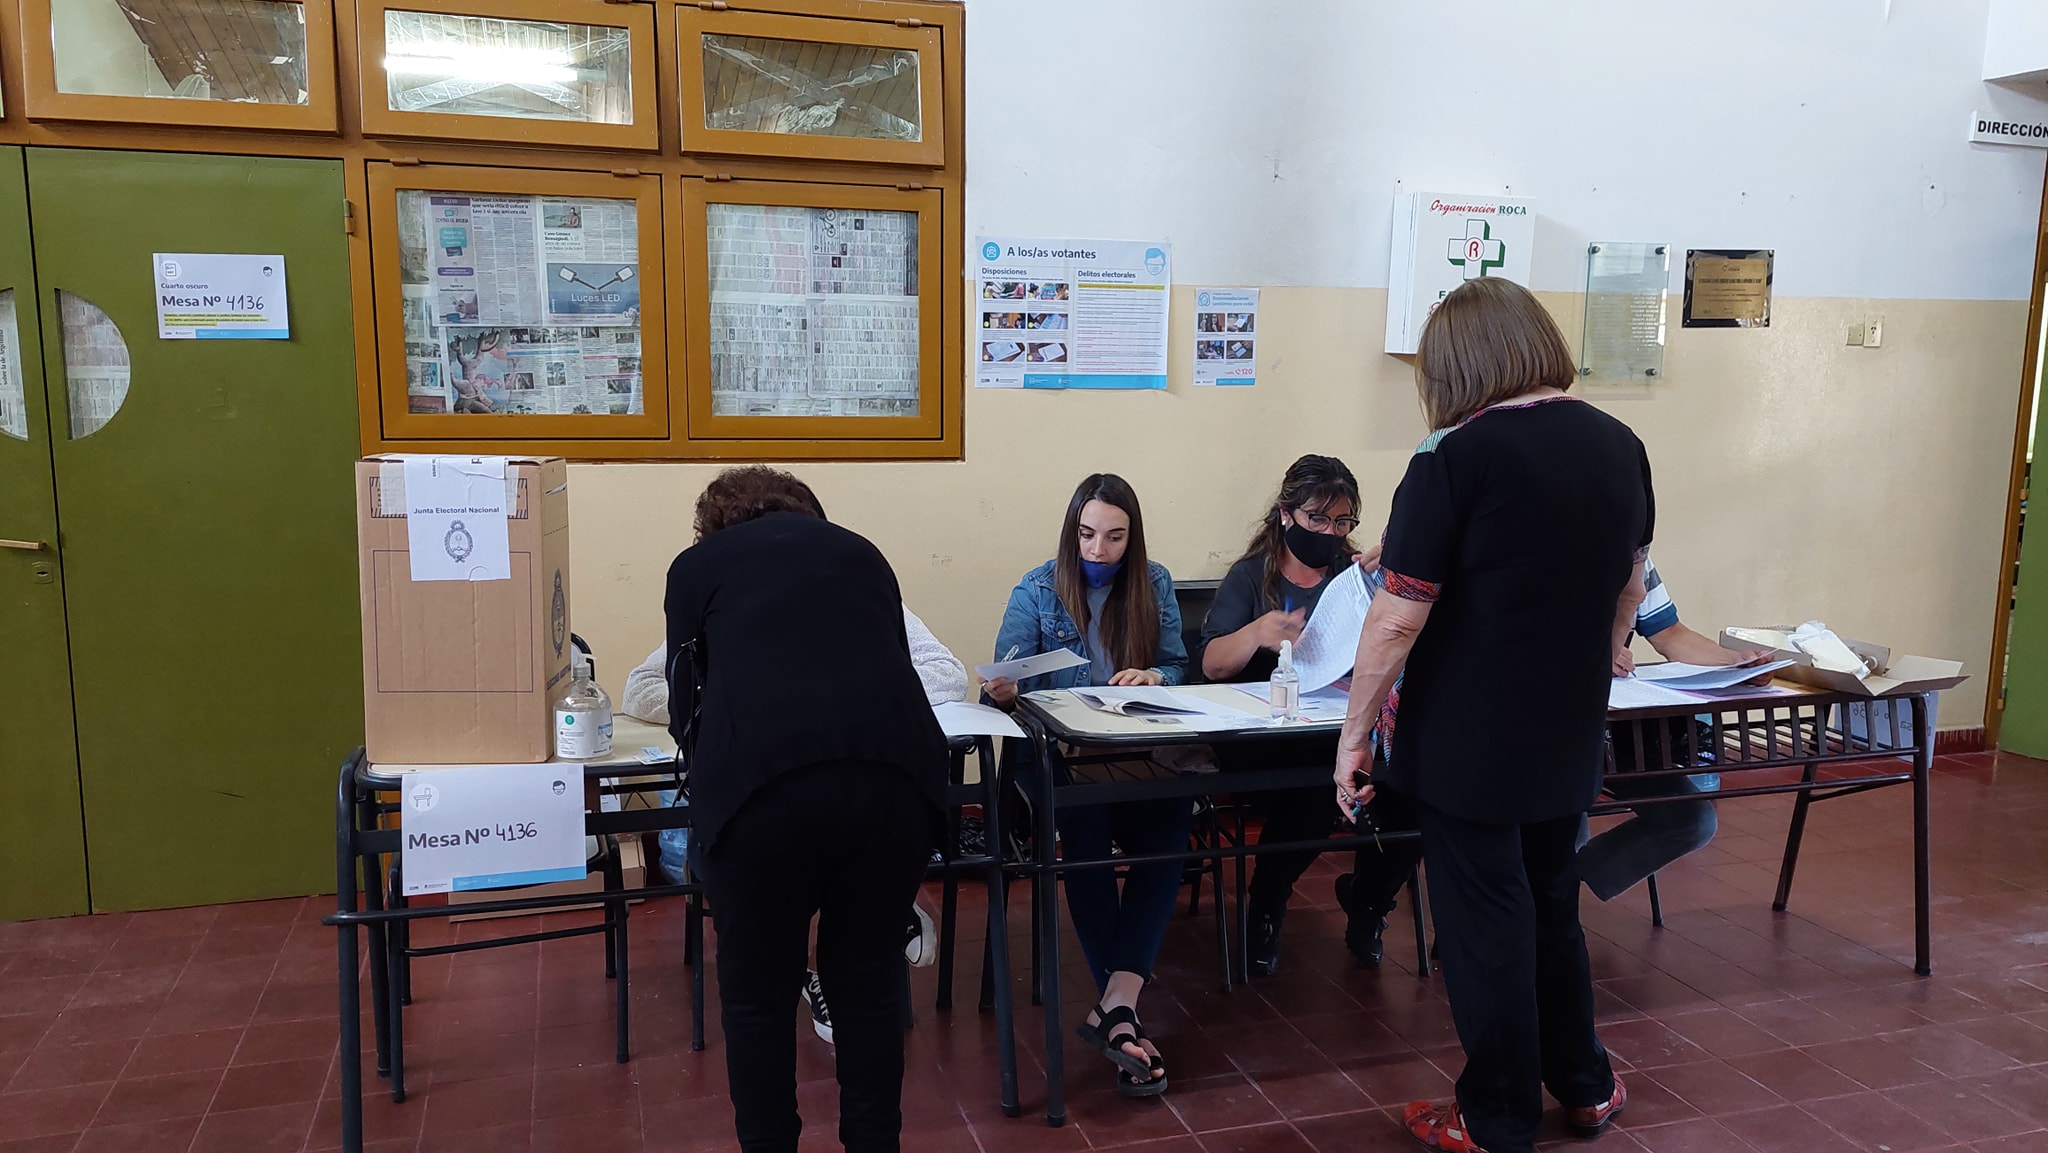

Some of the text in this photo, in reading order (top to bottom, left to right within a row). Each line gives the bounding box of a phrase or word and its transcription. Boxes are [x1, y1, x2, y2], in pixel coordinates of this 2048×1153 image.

[1977, 120, 2048, 138] DIRECCIÓN
[1431, 199, 1527, 215] Organización ROCA
[1007, 247, 1097, 259] A los/as votantes
[981, 267, 1027, 277] Disposiciones
[1077, 270, 1136, 279] Delitos electorales
[161, 295, 200, 307] Mesa
[226, 294, 265, 311] 4136
[571, 293, 600, 302] Luces
[468, 506, 500, 514] Nacional
[408, 832, 461, 850] Mesa
[495, 821, 538, 842] 4136
